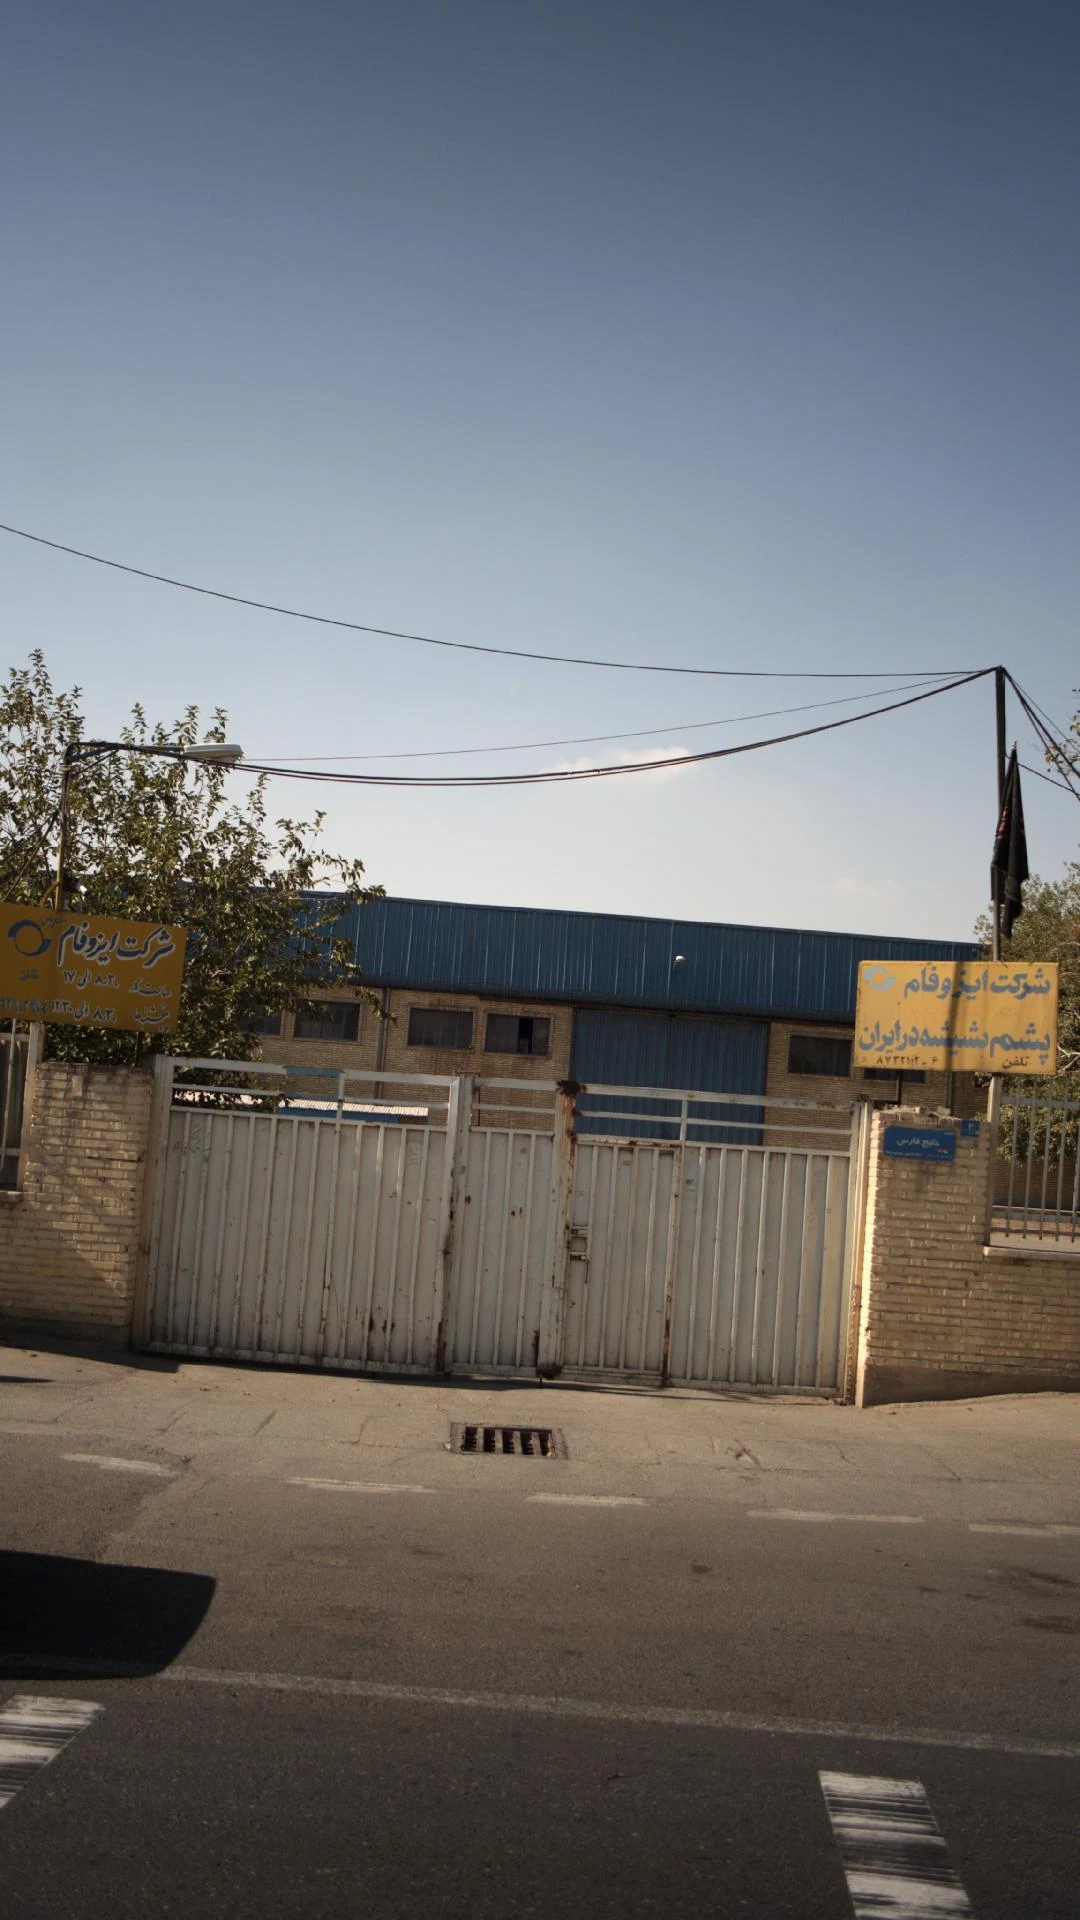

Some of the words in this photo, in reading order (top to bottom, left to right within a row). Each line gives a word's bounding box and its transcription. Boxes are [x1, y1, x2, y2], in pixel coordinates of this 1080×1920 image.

[116, 924, 176, 969] شرکت
[990, 967, 1051, 1000] شرکت
[859, 1019, 902, 1053] ایران
[896, 1026, 919, 1051] در
[919, 1019, 989, 1057] شیشه
[989, 1021, 1051, 1066] پشم
[1002, 1055, 1029, 1069] تلفن
[896, 1137, 920, 1146] فارس
[921, 1138, 940, 1148] خلیج
